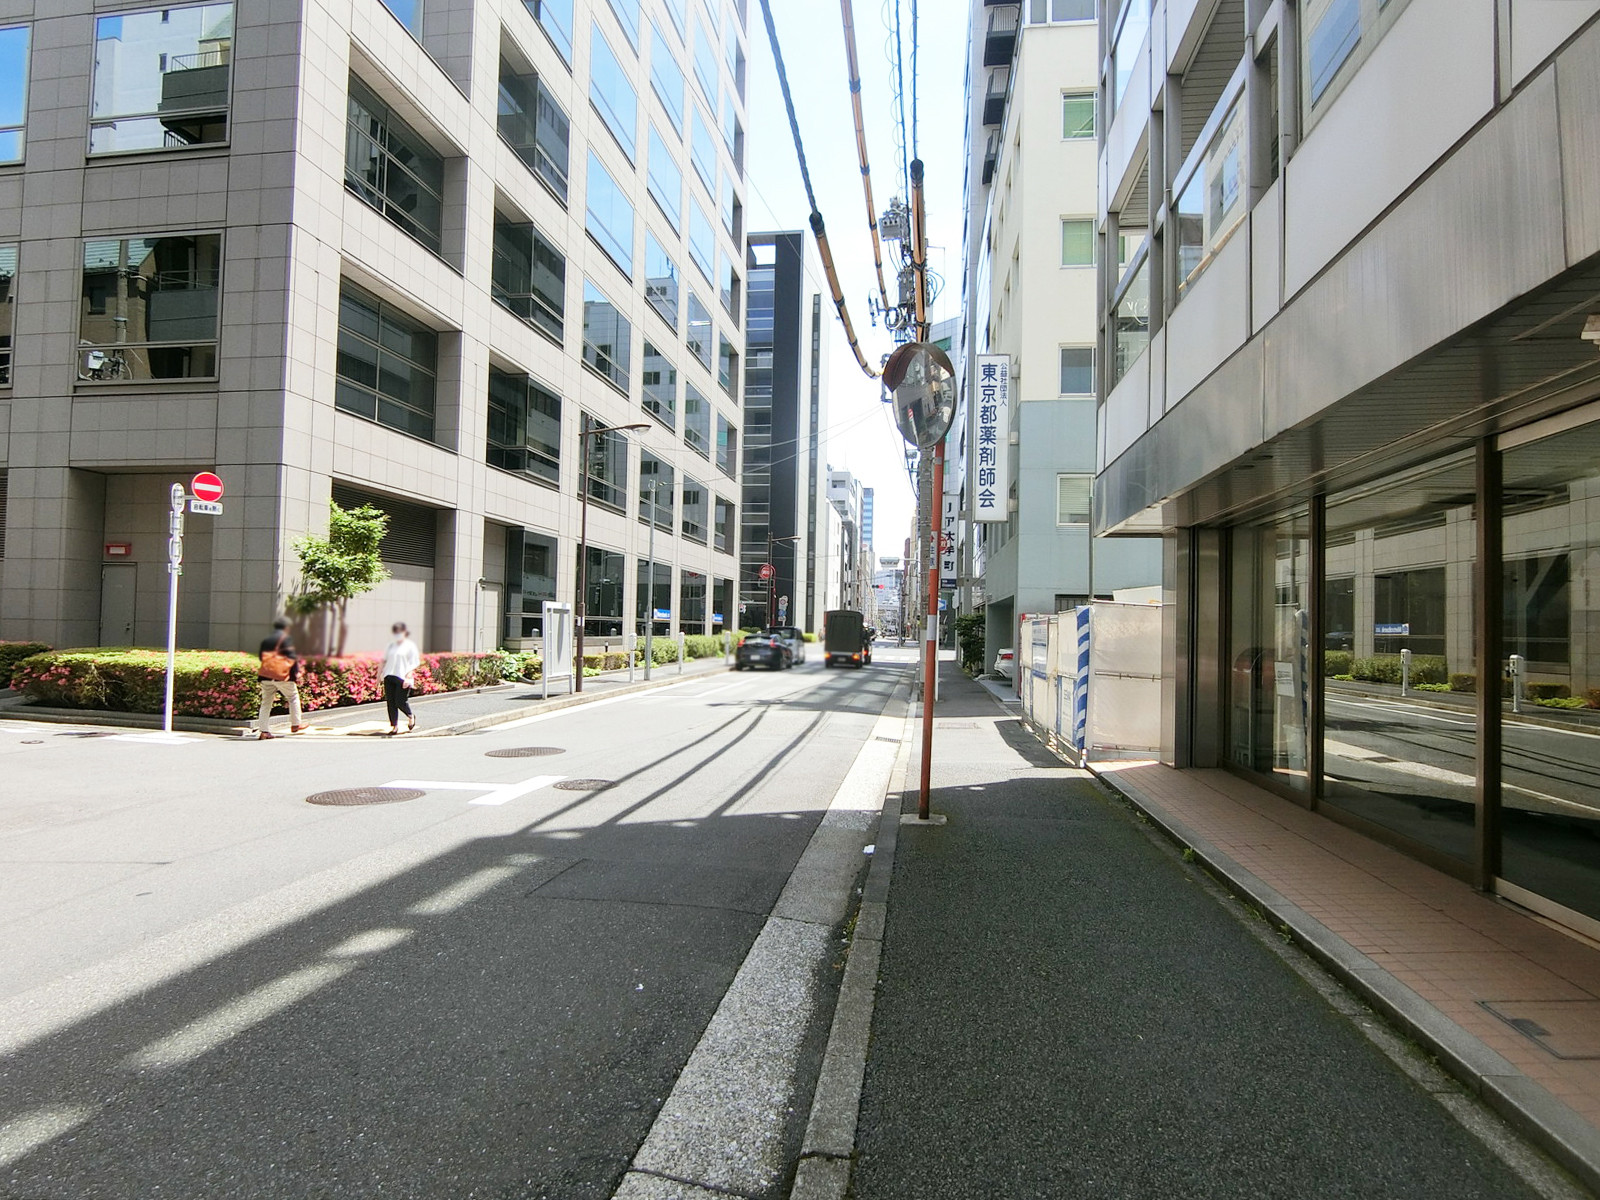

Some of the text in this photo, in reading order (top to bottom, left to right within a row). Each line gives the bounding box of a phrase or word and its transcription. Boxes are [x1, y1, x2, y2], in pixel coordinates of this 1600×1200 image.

[999, 362, 1008, 407] 公益社団法人
[978, 362, 998, 509] 東京都薬剤師会
